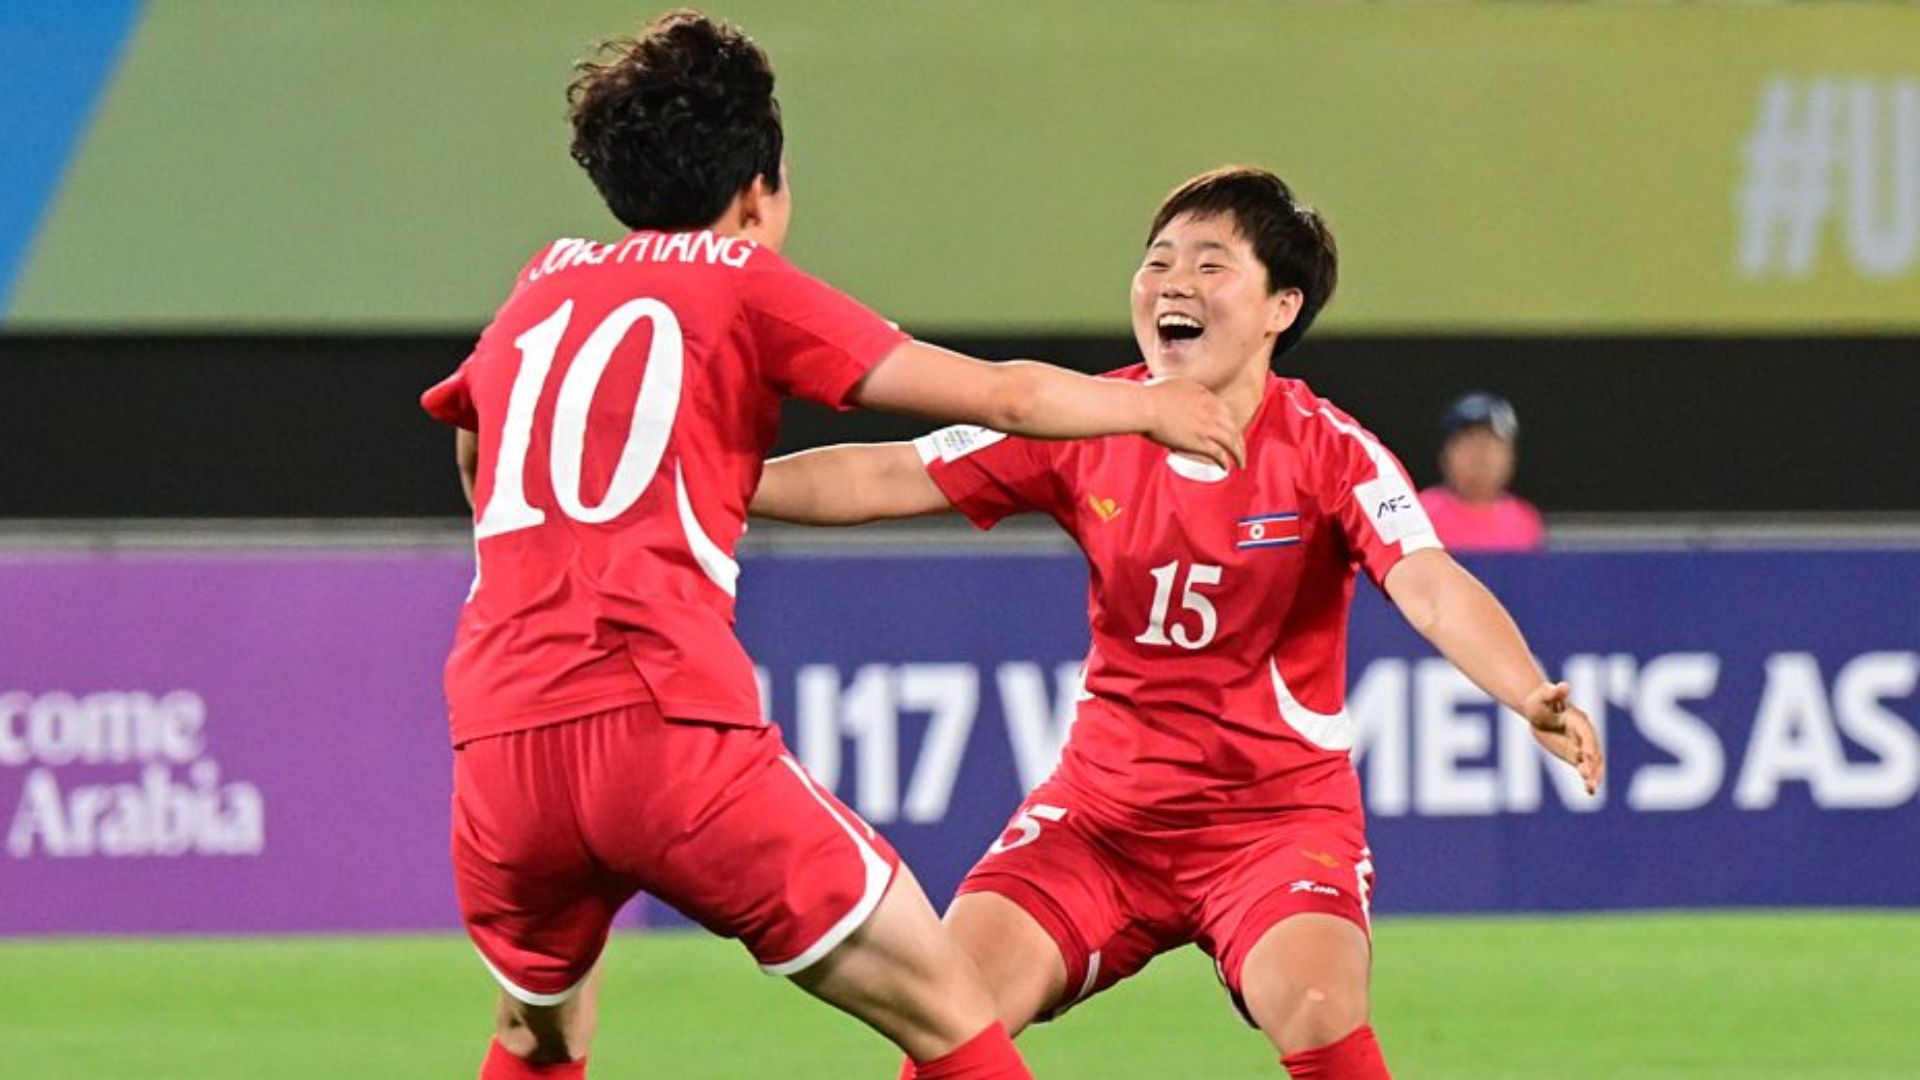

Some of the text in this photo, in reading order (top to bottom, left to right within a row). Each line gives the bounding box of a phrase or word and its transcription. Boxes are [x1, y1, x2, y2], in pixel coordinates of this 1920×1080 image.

[1739, 74, 1918, 278] #U
[475, 298, 684, 538] 10
[1135, 560, 1222, 650] 15
[0, 690, 206, 765] come
[1732, 650, 1920, 811] AS
[8, 758, 264, 857] Arabia
